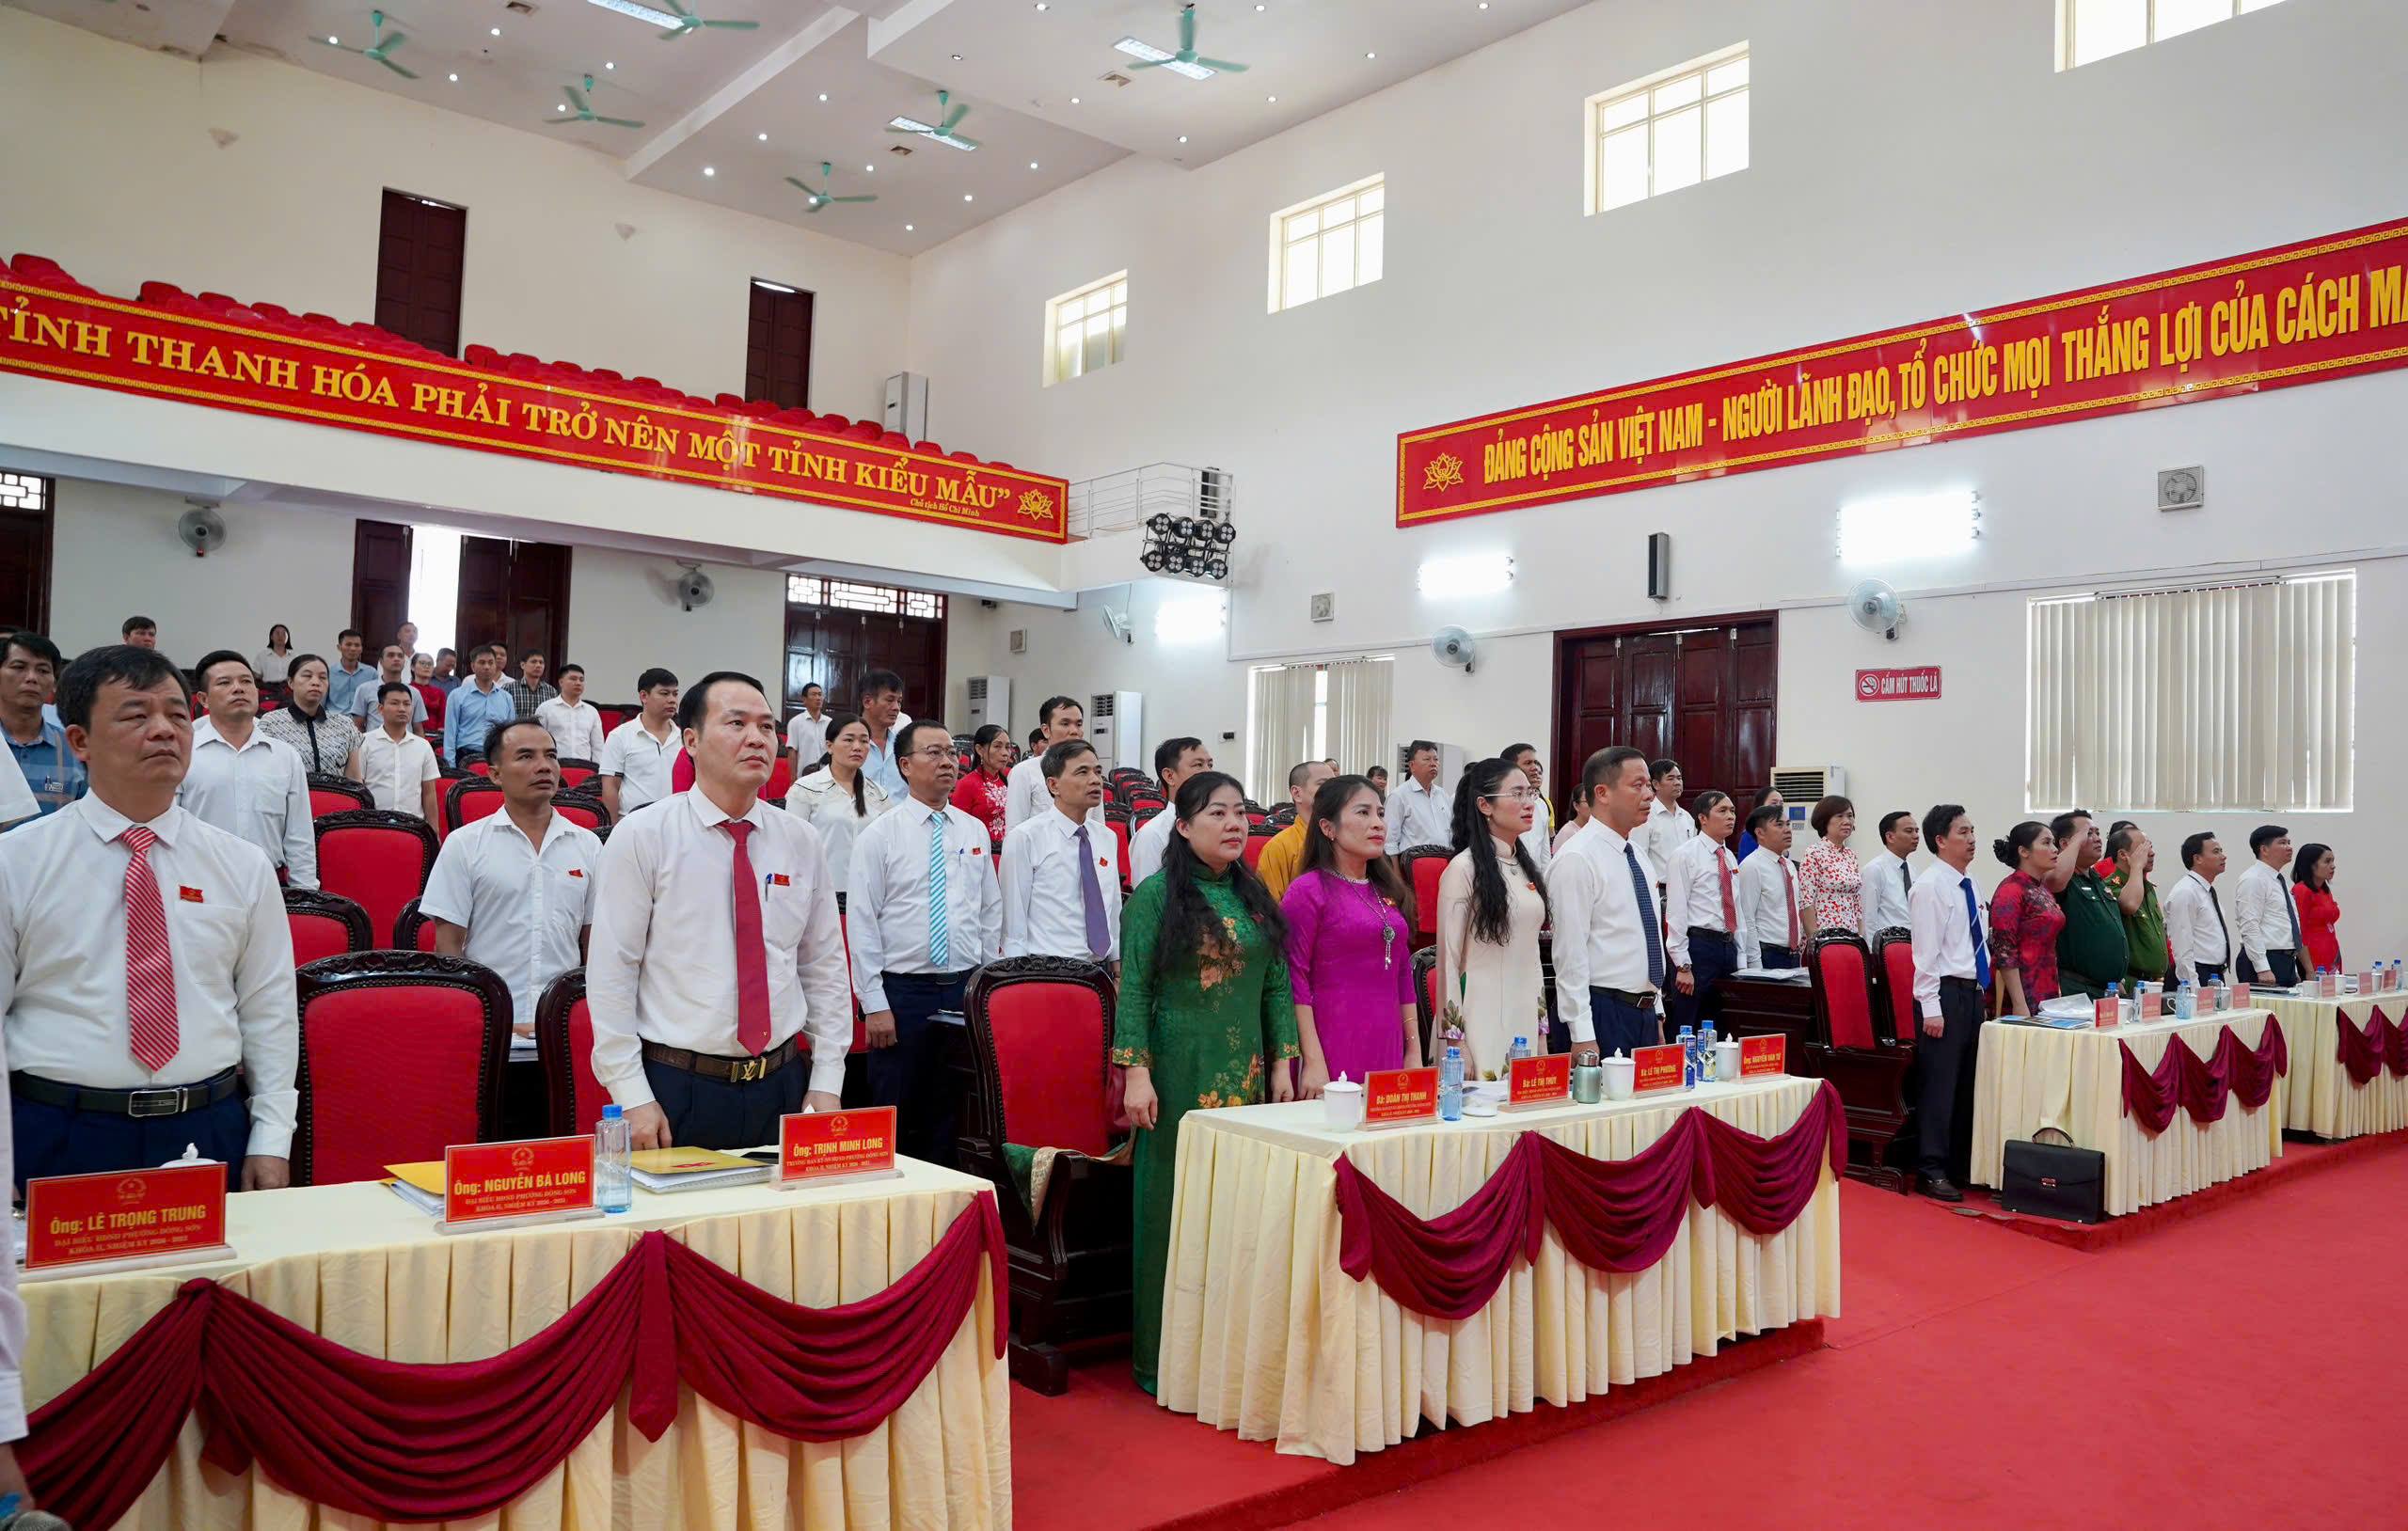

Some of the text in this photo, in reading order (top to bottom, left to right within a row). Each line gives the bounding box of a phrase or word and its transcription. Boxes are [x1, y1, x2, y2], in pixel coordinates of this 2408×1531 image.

[1483, 428, 1529, 483] ĐẢNG
[1530, 423, 1575, 481] CỘNG
[1577, 408, 1614, 466] SẢN
[1617, 404, 1656, 465] VIỆT
[1658, 402, 1703, 450] NAM
[1722, 379, 1784, 442] NGƯỜI
[1785, 374, 1843, 431] LÃNH
[1847, 369, 1896, 427] ĐẠO,
[1898, 339, 1927, 411] TỔ
[1933, 337, 1998, 404] CHỨC
[2004, 336, 2051, 399] MỌI
[2061, 305, 2150, 382] THẮNG
[2159, 301, 2202, 374] LỢI
[2210, 279, 2269, 356] CỦA
[2276, 273, 2360, 344] CÁCH
[0, 295, 112, 357] ỈNH
[127, 331, 299, 391] THANH
[310, 362, 399, 407] HÓA
[411, 382, 511, 427] PHẢI
[521, 401, 598, 442] TRỞ
[605, 413, 678, 455] NÊN
[688, 430, 760, 472] MỘT
[768, 437, 847, 483] TỈNH
[854, 457, 929, 497] KIỂU
[961, 507, 980, 517] Minh
[1909, 670, 1929, 693] THUỐC
[1929, 671, 1939, 692] LÁ
[793, 1137, 883, 1158] Ông: TRỊNH MINH LONG
[454, 1178, 482, 1196] Ông:
[484, 1172, 533, 1192] NGUYỄN
[555, 1170, 586, 1186] LONG
[50, 1205, 207, 1236] Ông: LÊ TRỌNG TRUNG
